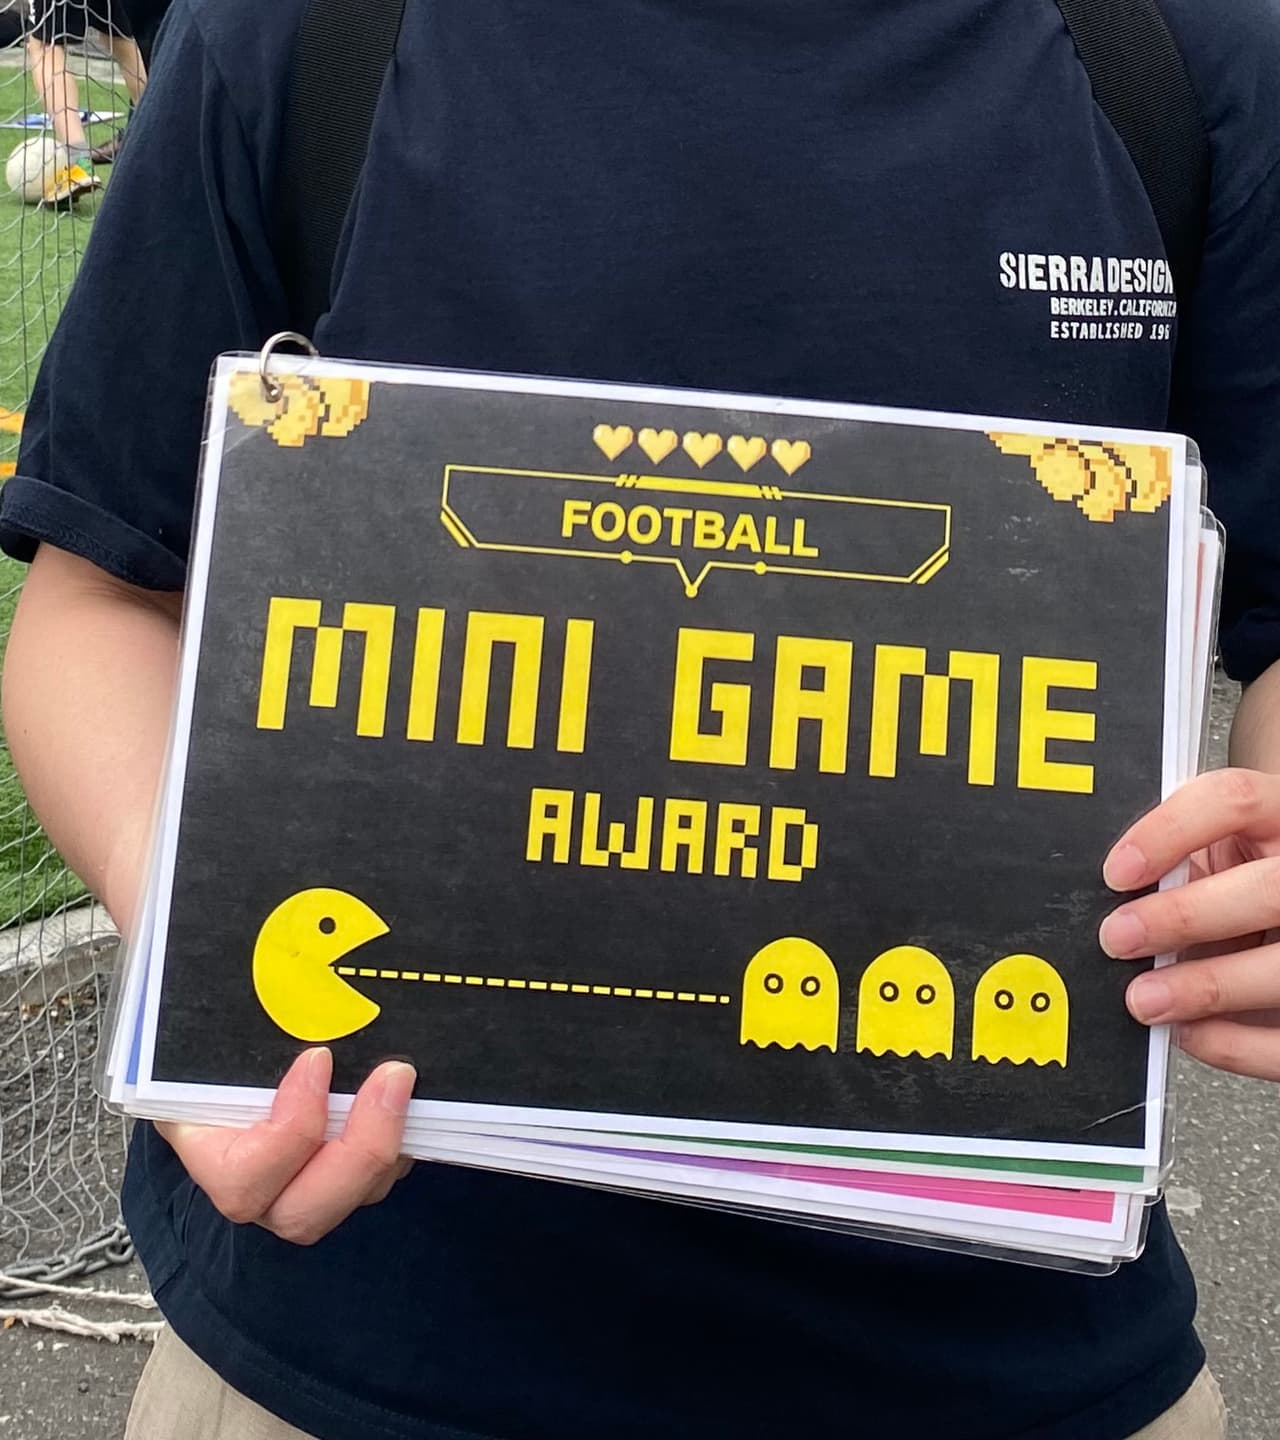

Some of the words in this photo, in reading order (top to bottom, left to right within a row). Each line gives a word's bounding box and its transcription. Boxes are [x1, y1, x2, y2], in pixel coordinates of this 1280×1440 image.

[1050, 320, 1144, 340] ESTABLISHED
[561, 499, 819, 558] FOOTBALL
[256, 596, 595, 753] MINI
[669, 627, 1098, 794] GAME
[526, 787, 819, 882] AWARD
